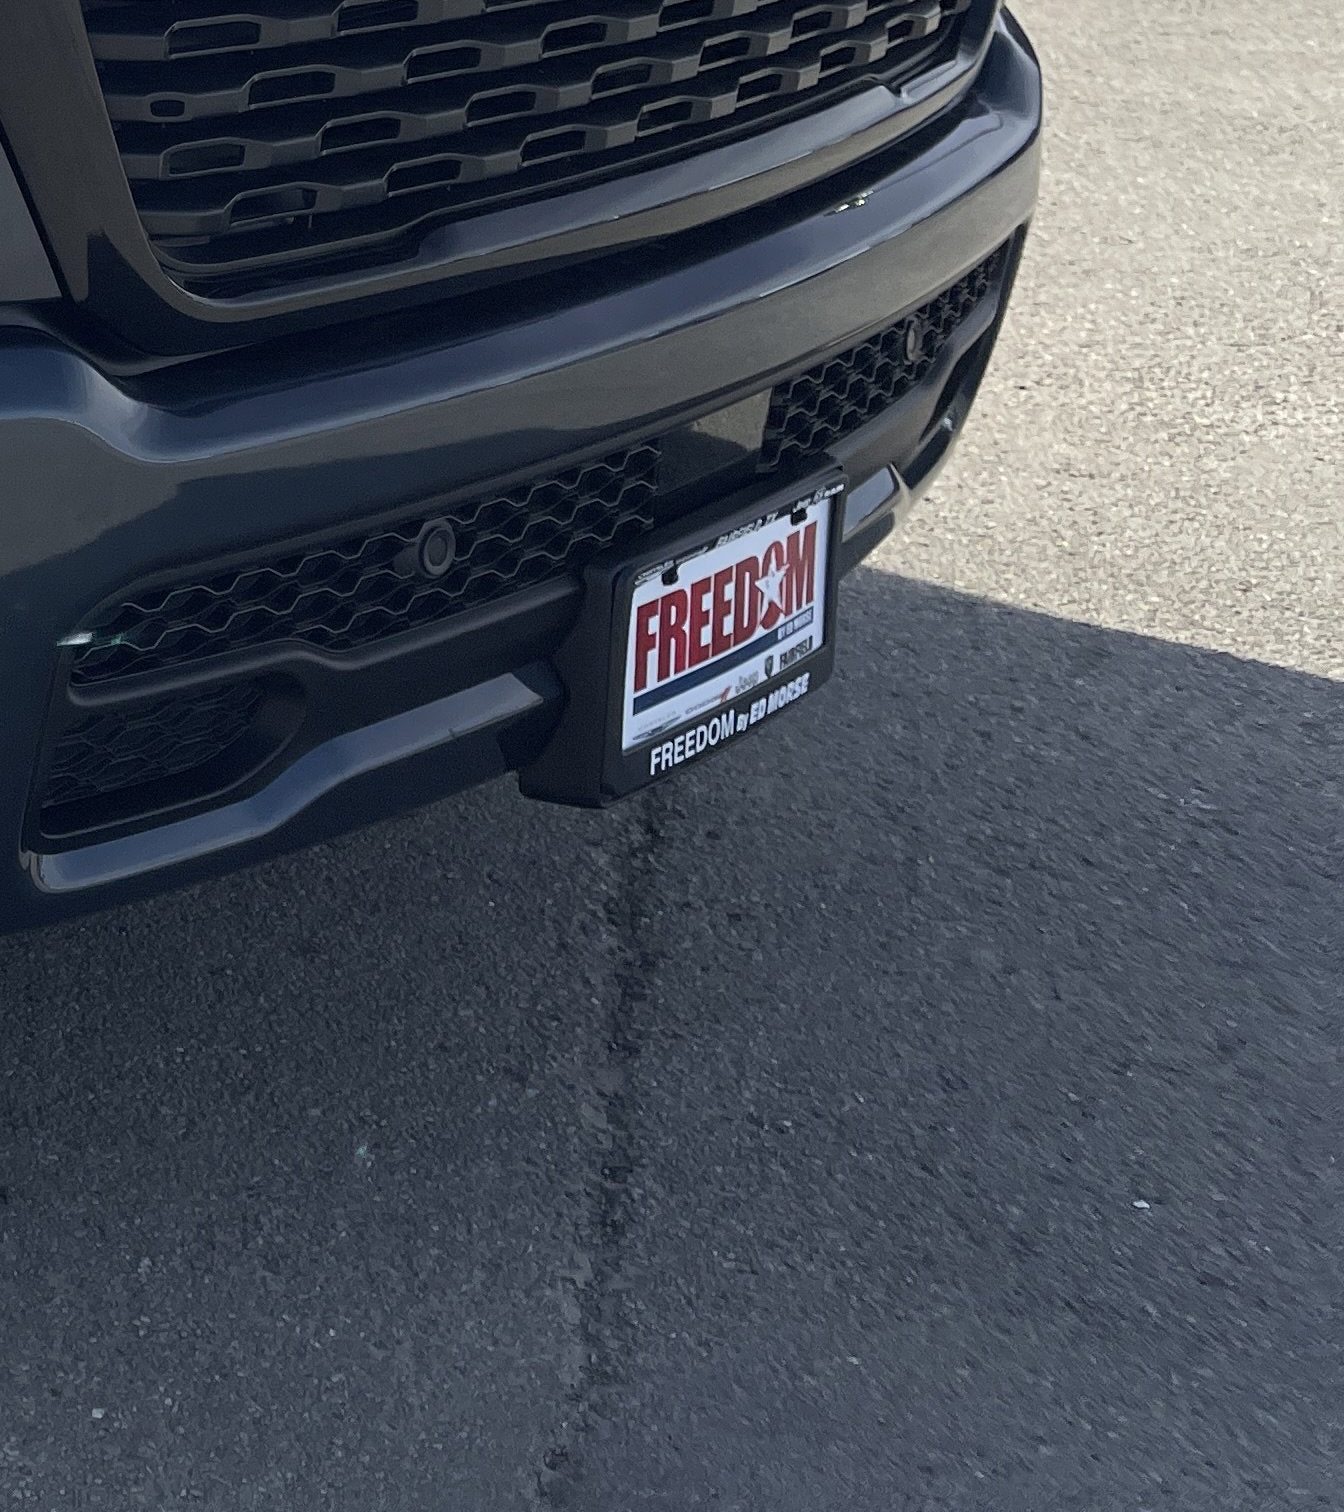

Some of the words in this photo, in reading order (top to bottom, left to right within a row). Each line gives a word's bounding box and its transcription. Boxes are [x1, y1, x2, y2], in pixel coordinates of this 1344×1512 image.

[633, 521, 818, 694] FREEDOM
[650, 709, 735, 776] FREEDOM
[749, 697, 767, 725] ED
[767, 672, 811, 715] MORSE
